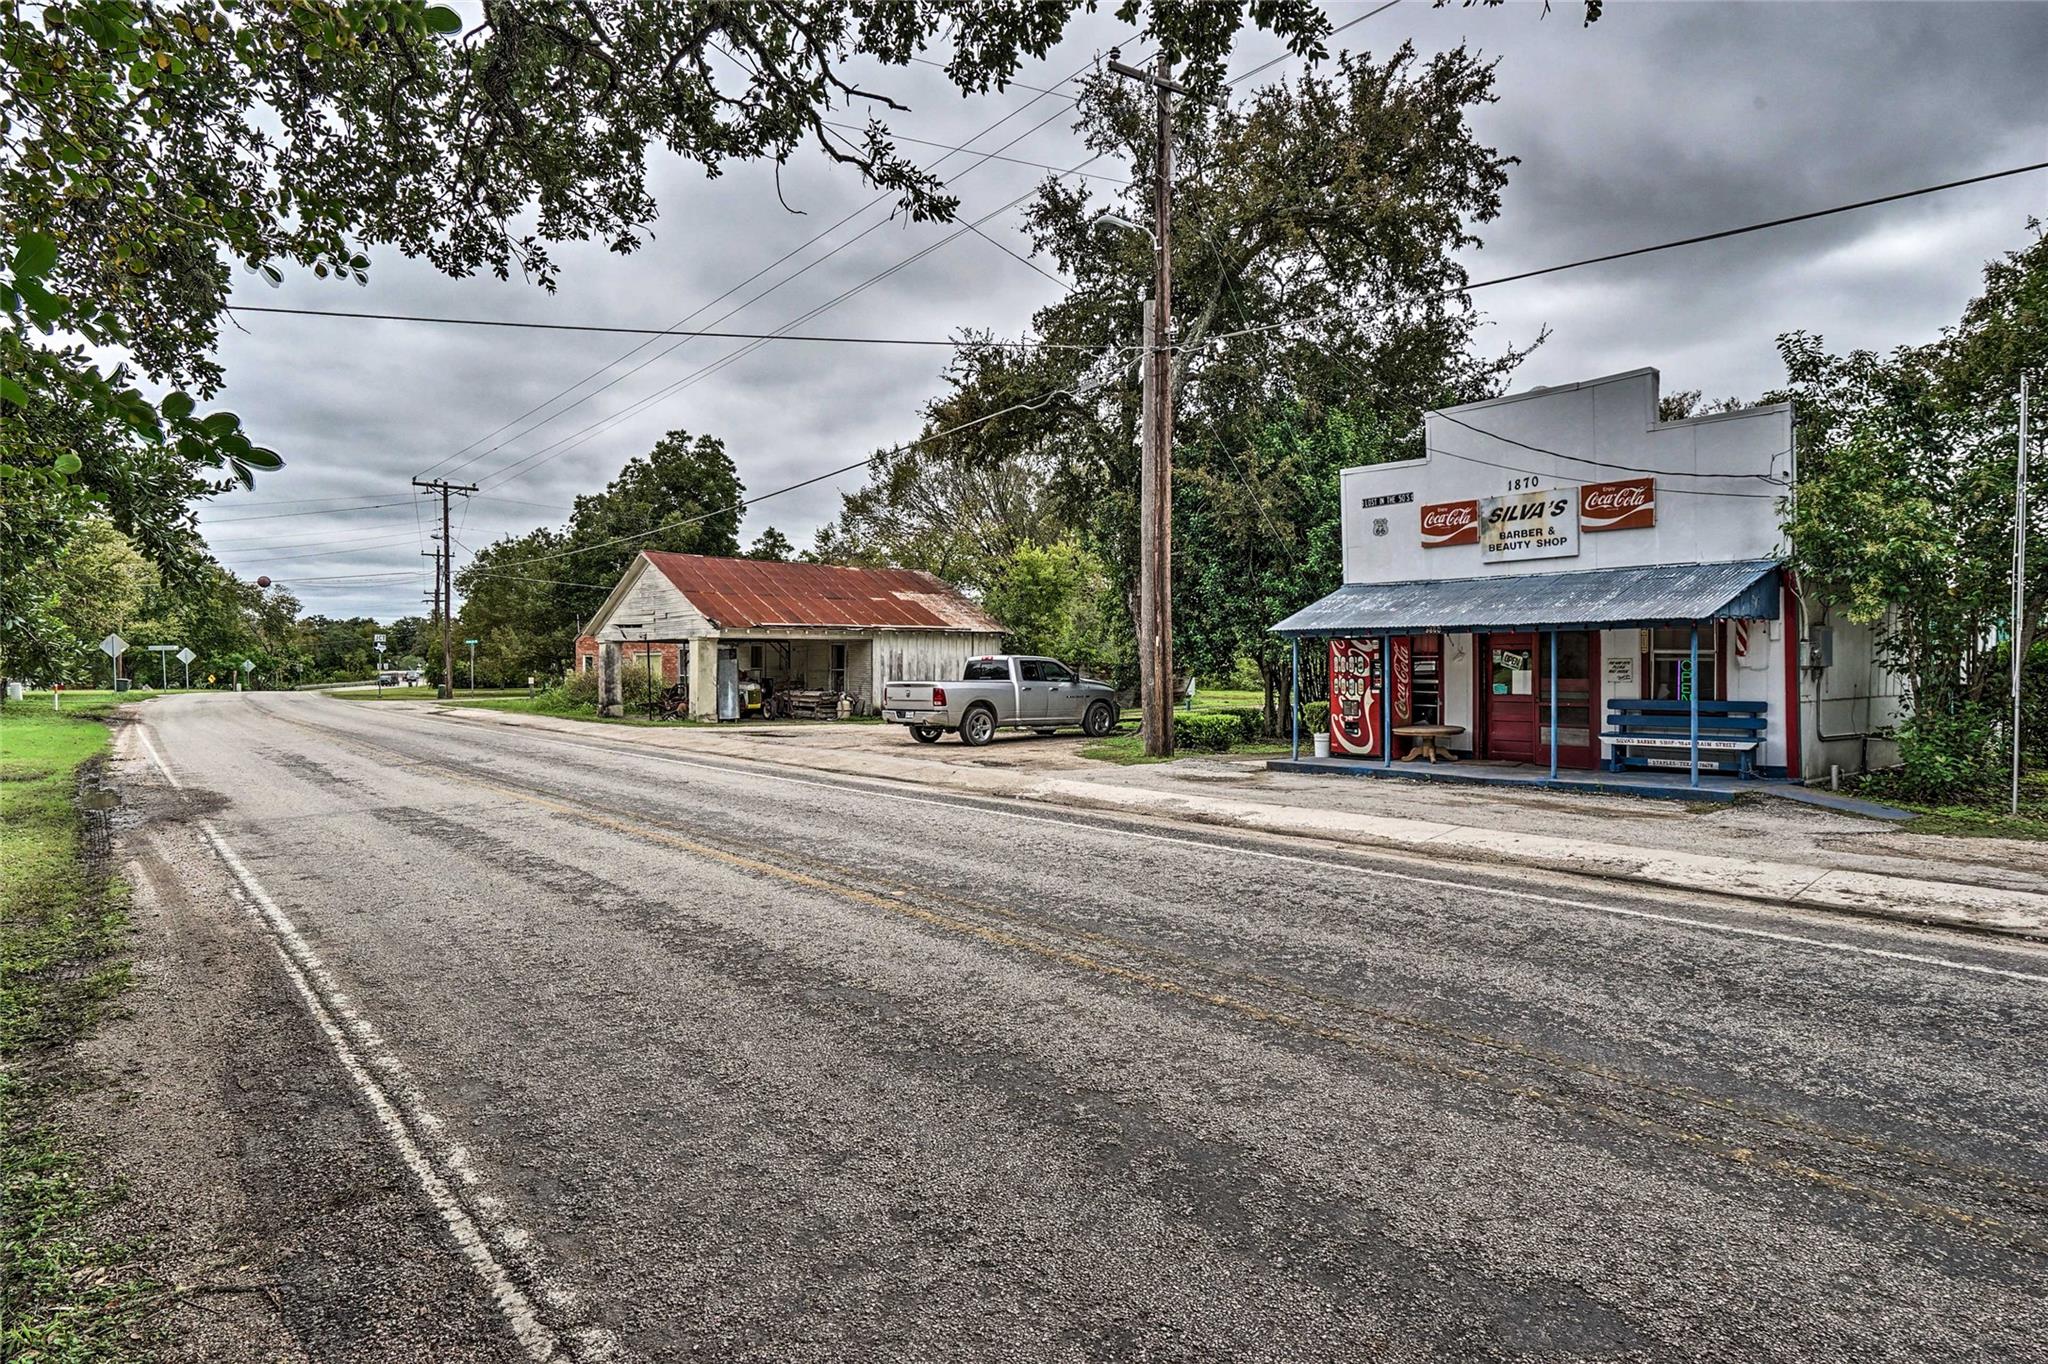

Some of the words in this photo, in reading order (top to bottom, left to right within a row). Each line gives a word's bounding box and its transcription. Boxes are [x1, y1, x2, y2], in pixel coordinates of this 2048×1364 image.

[1508, 476, 1539, 491] 1870
[1364, 498, 1377, 507] LOST
[1379, 497, 1385, 505] IN
[1386, 496, 1396, 504] THE
[1584, 486, 1648, 511] Coca-Cola
[1423, 507, 1472, 528] Coca-Cola
[1488, 499, 1568, 524] SILVA'S
[1500, 528, 1543, 540] BARBER
[1548, 526, 1556, 535] &
[1488, 540, 1531, 552] BEAUTY
[1536, 537, 1568, 548] SHOP
[1394, 641, 1409, 720] Coca-Cola
